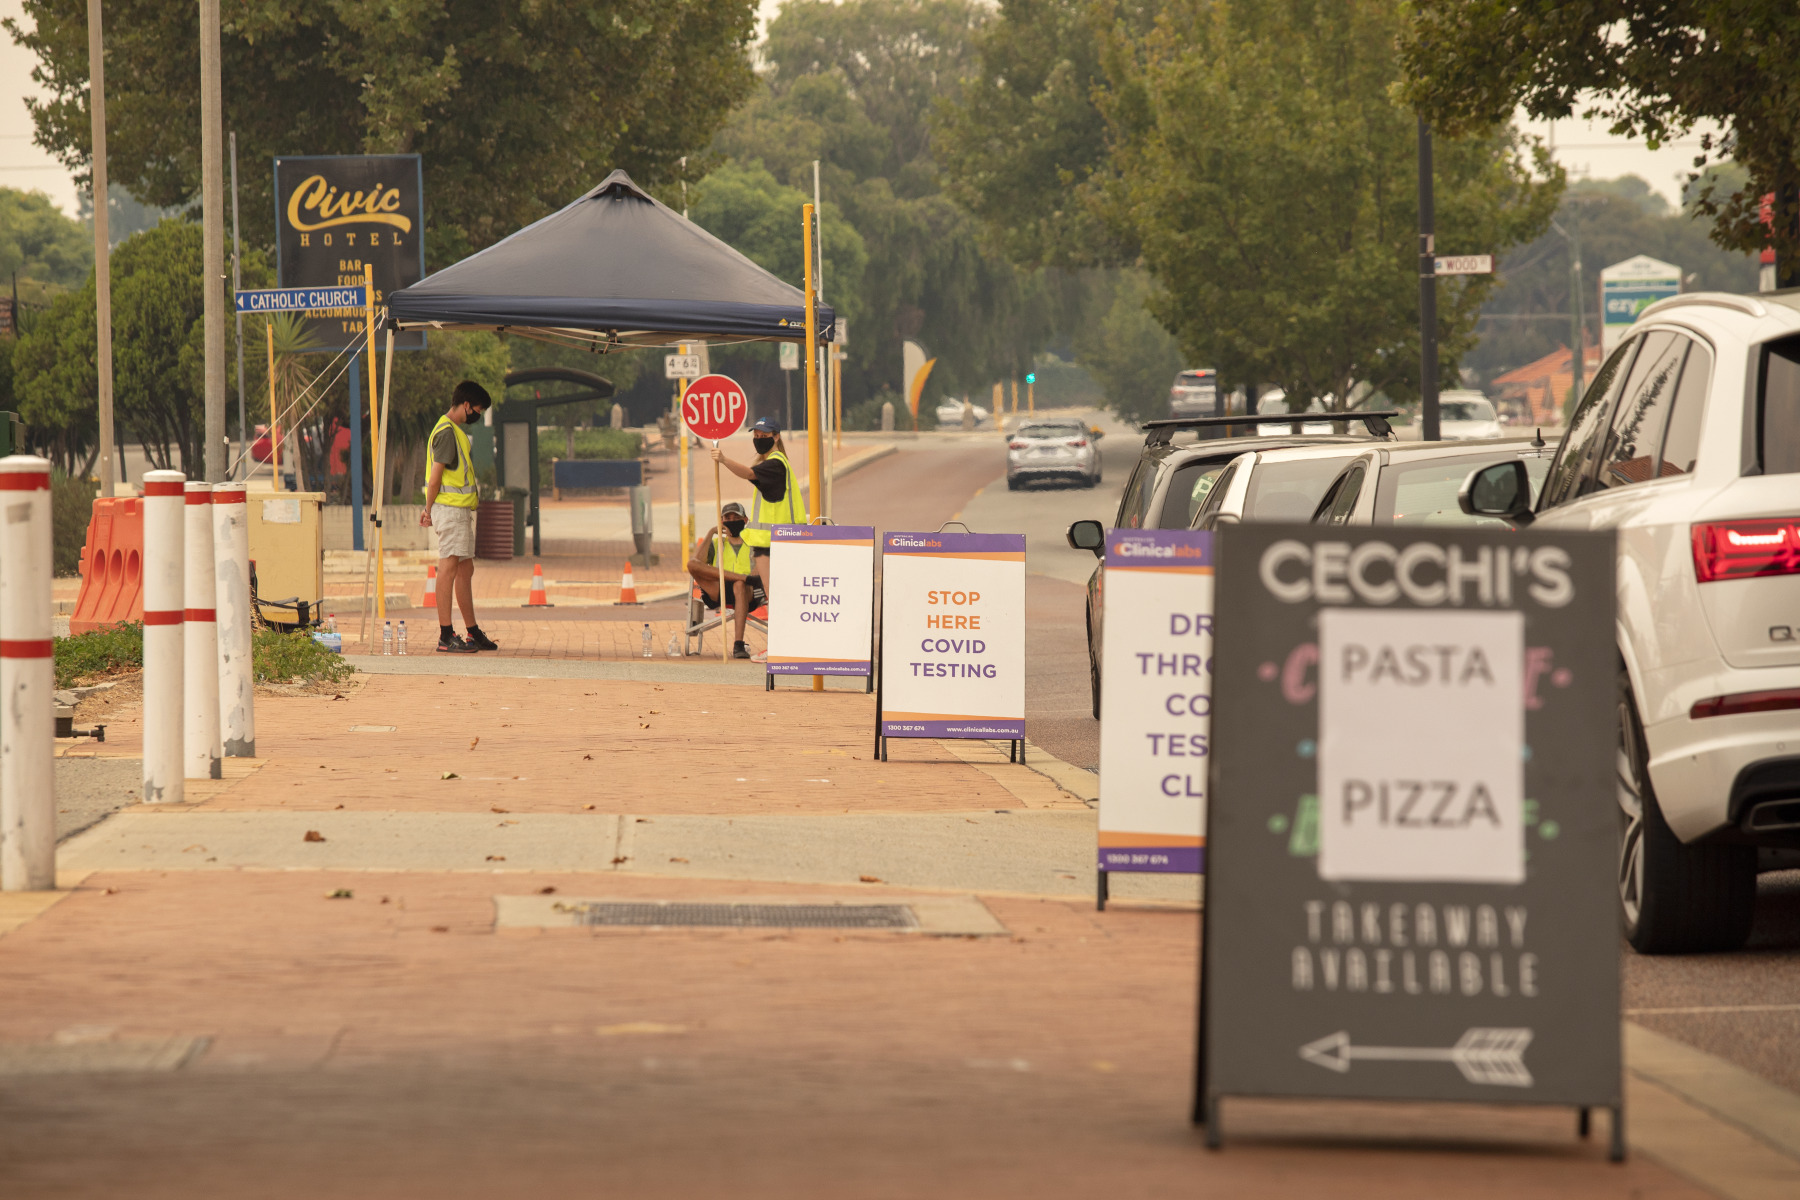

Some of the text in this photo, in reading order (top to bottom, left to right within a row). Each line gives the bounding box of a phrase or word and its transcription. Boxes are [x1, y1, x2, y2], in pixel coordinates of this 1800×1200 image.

[287, 174, 411, 234] Civic
[300, 233, 402, 247] HOTEL
[340, 259, 362, 272] BAR
[1447, 257, 1478, 270] WOOD
[250, 292, 306, 310] CATHOLIC
[309, 290, 358, 307] CHURCH
[342, 321, 364, 333] TAB
[668, 358, 675, 368] 4
[683, 359, 689, 368] 6
[686, 392, 742, 425] STOP
[1192, 478, 1214, 498] P
[803, 576, 840, 587] LEFT
[1260, 540, 1574, 607] CECCHI'S
[800, 594, 840, 605] TURN
[928, 590, 980, 606] STOP
[800, 612, 840, 622] ONLY
[928, 615, 980, 630] HERE
[1171, 614, 1213, 636] DR
[1768, 625, 1800, 642] Q
[921, 638, 986, 654] COVID
[910, 662, 997, 678] TESTING
[1136, 652, 1212, 676] THR
[1341, 643, 1495, 687] PASTA
[1165, 694, 1211, 717] CO
[1146, 734, 1208, 757] TES
[1160, 774, 1203, 798] CL
[1341, 779, 1501, 828] PIZZA
[1304, 900, 1528, 949] TAKEAWAY
[1291, 945, 1539, 997] AVAILABLE
